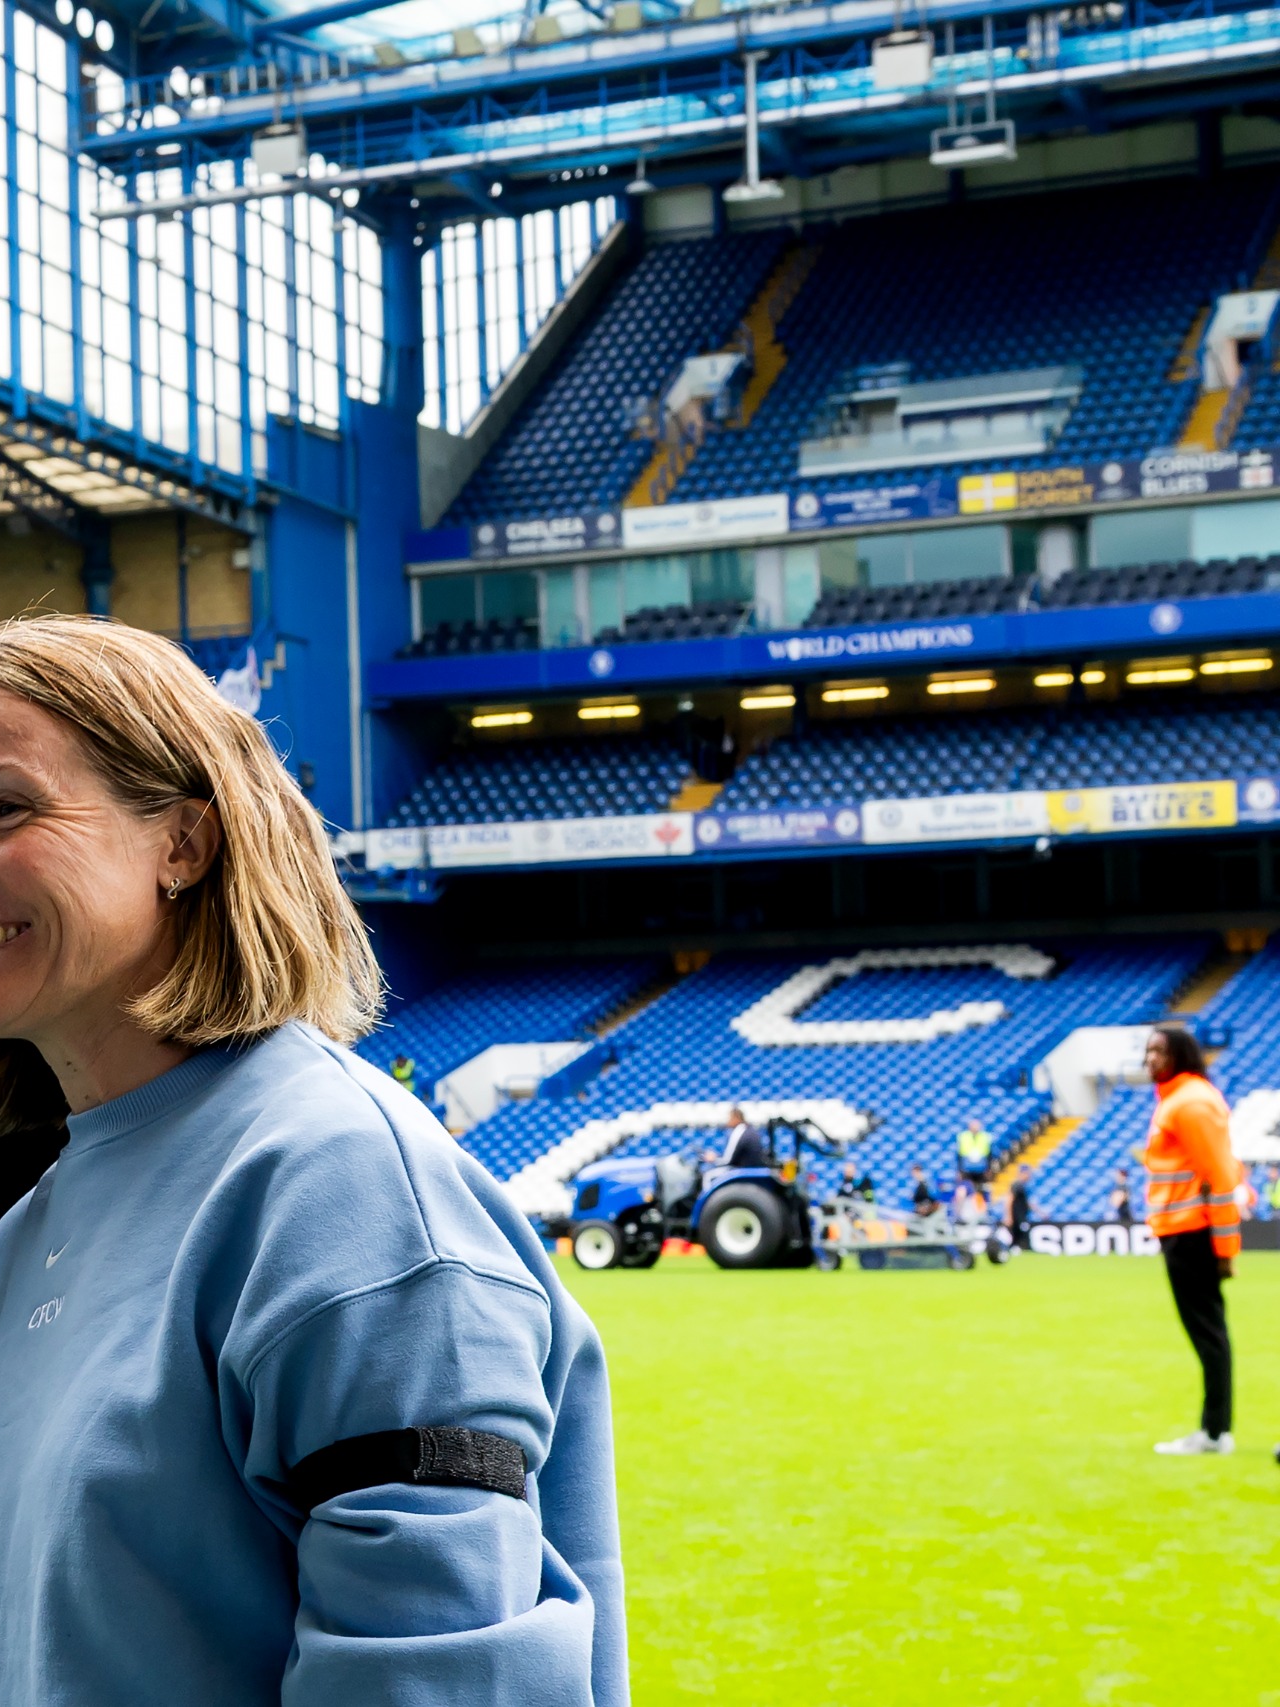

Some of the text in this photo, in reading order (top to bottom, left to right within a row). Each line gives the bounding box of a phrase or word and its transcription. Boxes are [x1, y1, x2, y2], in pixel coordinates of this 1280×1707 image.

[1141, 450, 1238, 476] CORNISH
[1019, 469, 1085, 490] SOUTH
[1141, 473, 1208, 498] BLUES
[1019, 484, 1094, 508] DORSET
[846, 624, 974, 655] CHAMPIONS
[1112, 790, 1214, 804] SAFFRON
[1112, 803, 1215, 823] BLUES
[379, 826, 513, 849] CHESEA INDIA
